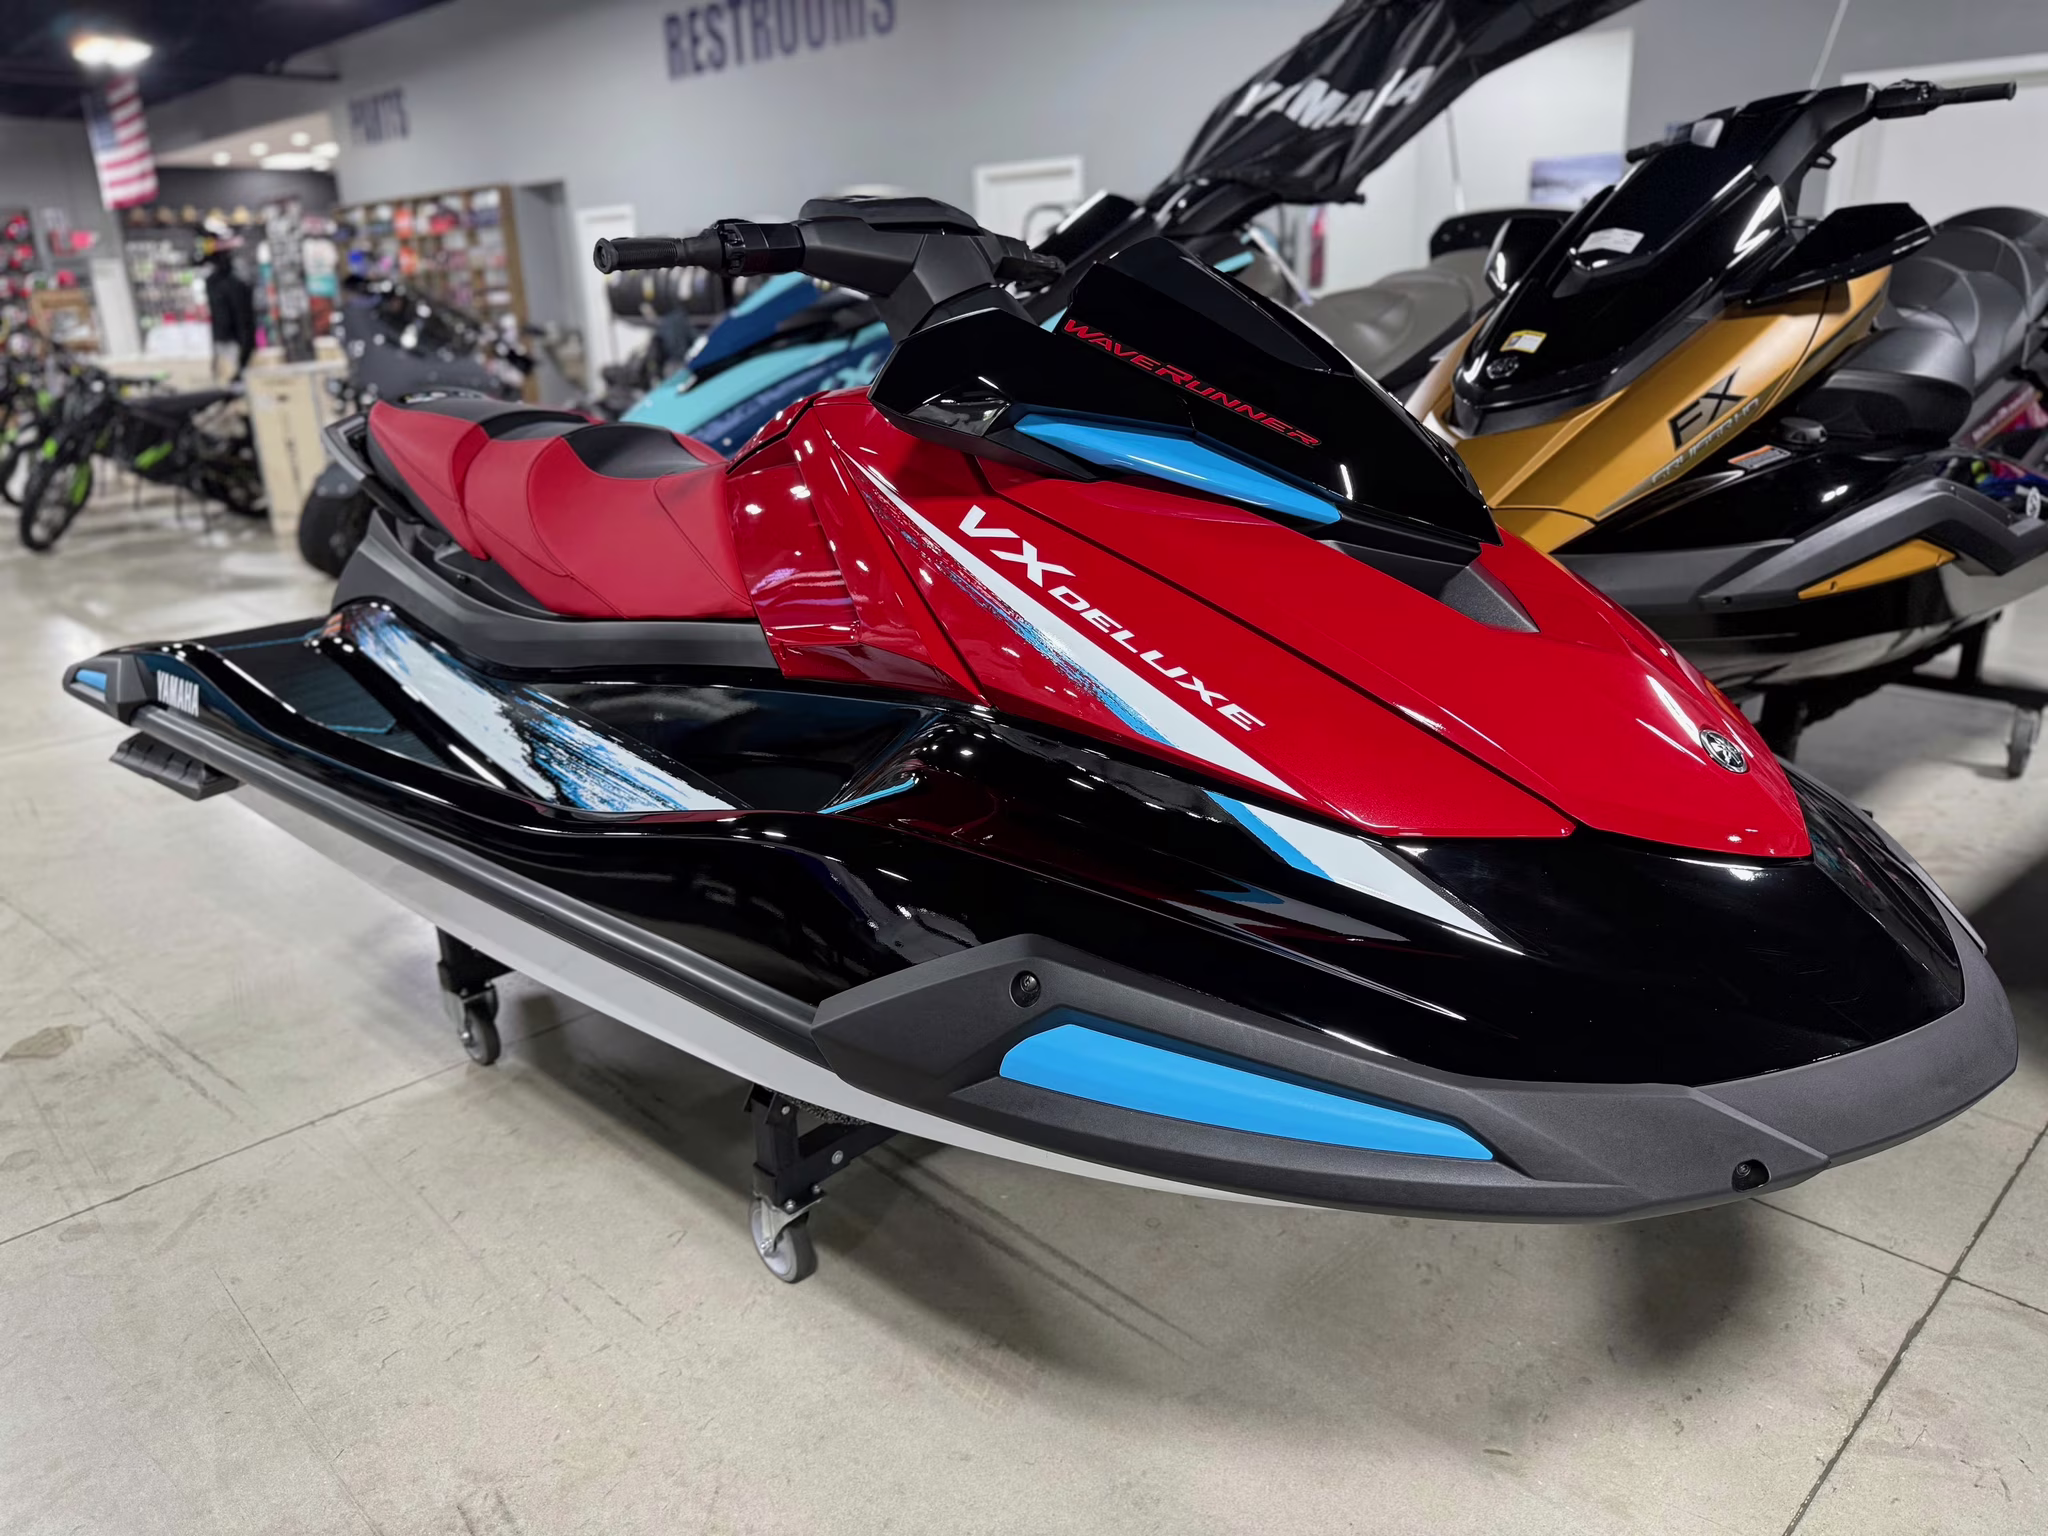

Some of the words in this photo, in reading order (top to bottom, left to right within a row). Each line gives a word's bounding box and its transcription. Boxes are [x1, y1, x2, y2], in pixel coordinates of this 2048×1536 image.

[664, 0, 896, 81] RESTROOMS
[1064, 319, 1321, 446] WAVERUNNER
[1668, 365, 1748, 452] FX
[959, 504, 1077, 588] VX
[1047, 585, 1267, 732] DELUXE
[156, 668, 200, 718] YAMAHA
